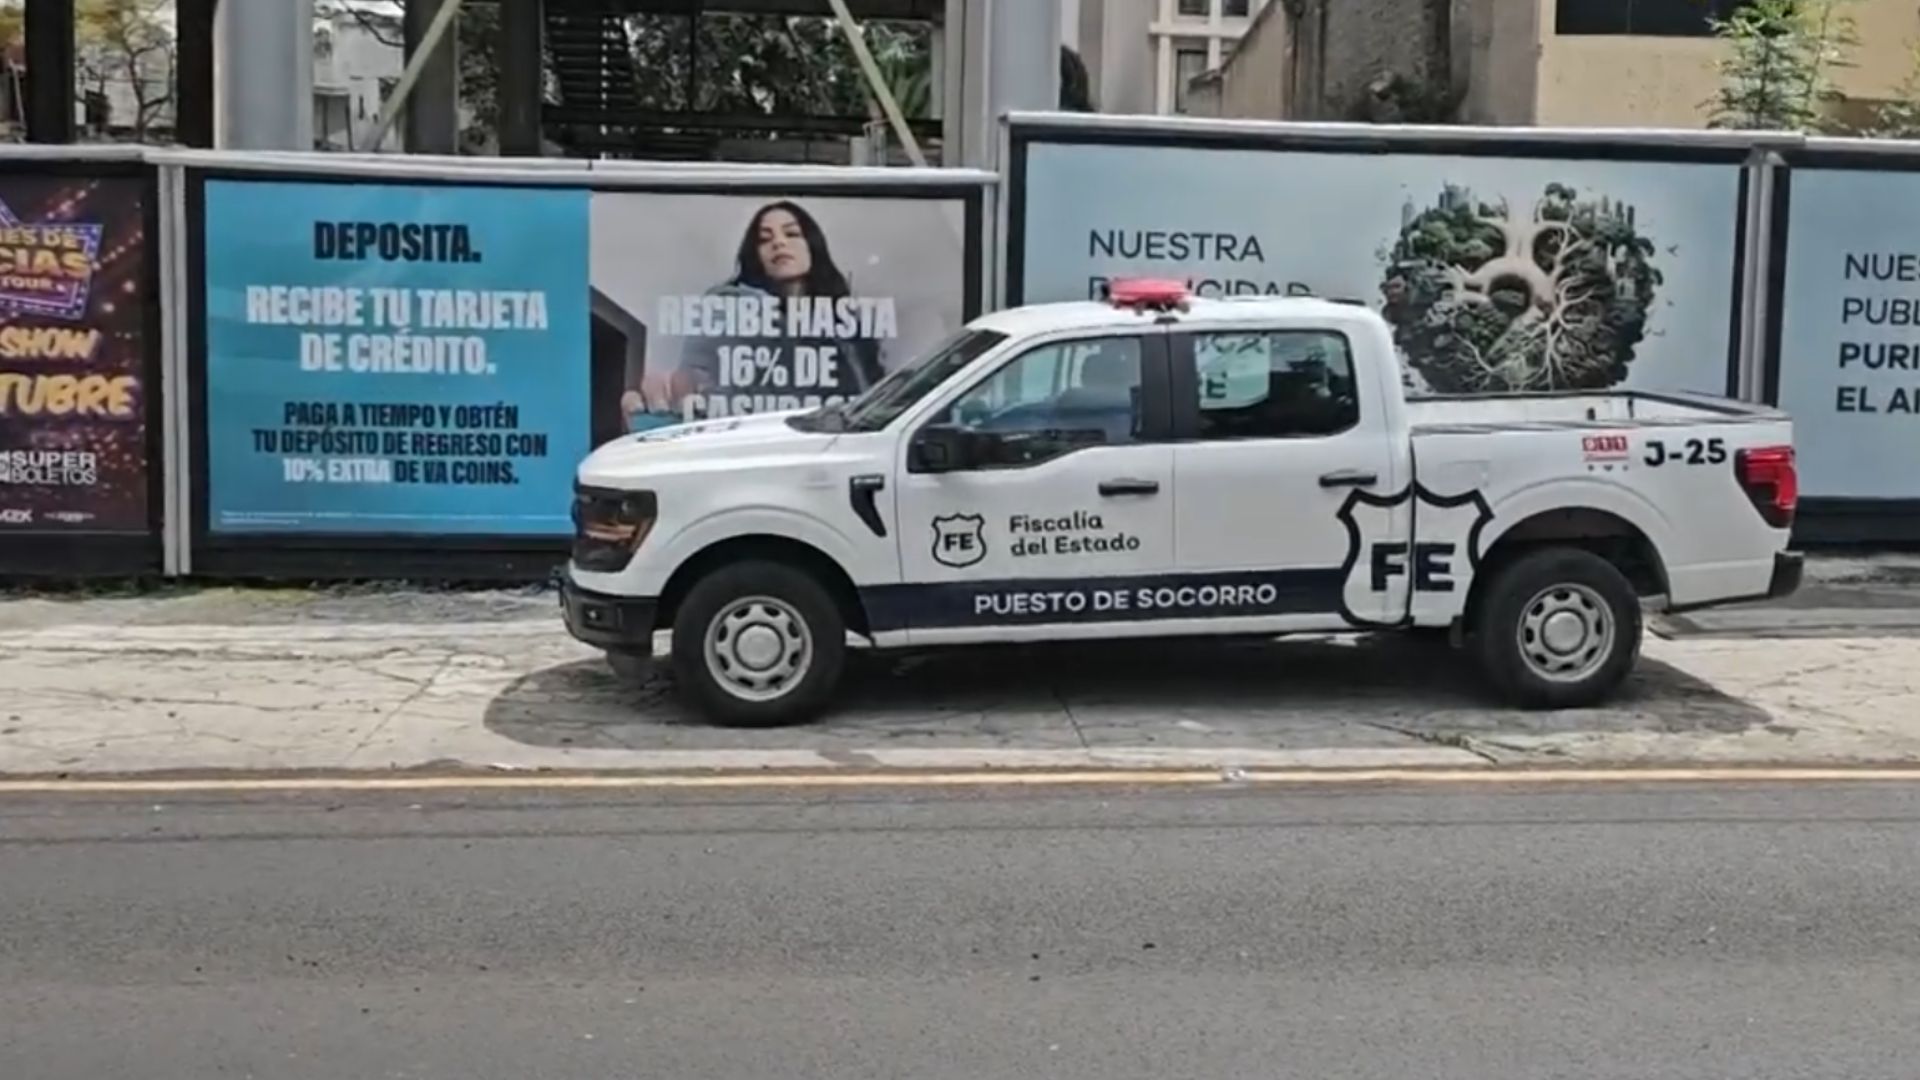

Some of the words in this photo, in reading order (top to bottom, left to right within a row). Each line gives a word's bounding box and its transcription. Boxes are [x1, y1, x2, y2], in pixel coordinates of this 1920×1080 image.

[0, 227, 38, 247] ES
[313, 220, 483, 264] DEPOSITA.
[1088, 229, 1266, 263] NUESTRA
[1844, 252, 1920, 282] NUE
[246, 284, 365, 327] RECIBE
[369, 286, 412, 328] TU
[416, 288, 549, 331] TARJETA
[658, 294, 782, 338] RECIBE
[786, 294, 898, 339] HASTA
[0, 325, 101, 359] SHOW
[299, 332, 342, 373] DE
[347, 326, 498, 376] CRÉDITO.
[716, 345, 789, 389] 16%
[793, 346, 839, 388] DE
[1836, 385, 1878, 413] EL
[284, 401, 339, 427] PAGA
[341, 403, 357, 427] A
[358, 402, 436, 428] TIEMPO
[437, 404, 452, 428] Y
[454, 400, 520, 430] OBTÉN
[252, 429, 278, 453] TU
[280, 426, 380, 455] DEPÓSITO
[382, 431, 409, 456] DE
[411, 431, 502, 457] REGRESO
[504, 433, 548, 458] CON
[1643, 438, 1728, 467] J-25
[11, 449, 97, 469] SUPER
[282, 457, 325, 483] 10%
[327, 457, 392, 483] EXTRA
[393, 459, 420, 483] DE
[423, 460, 449, 485] VA
[451, 460, 520, 486] COINS.
[11, 467, 97, 485] BOLETOS
[1009, 510, 1105, 534] Fiscalía
[943, 531, 976, 553] FE
[1010, 536, 1049, 558] del
[1054, 533, 1142, 556] Estado
[1371, 541, 1456, 593] FE
[974, 590, 1088, 616] PUESTO
[1093, 588, 1131, 611] DE
[1135, 582, 1279, 609] SOCORRO
